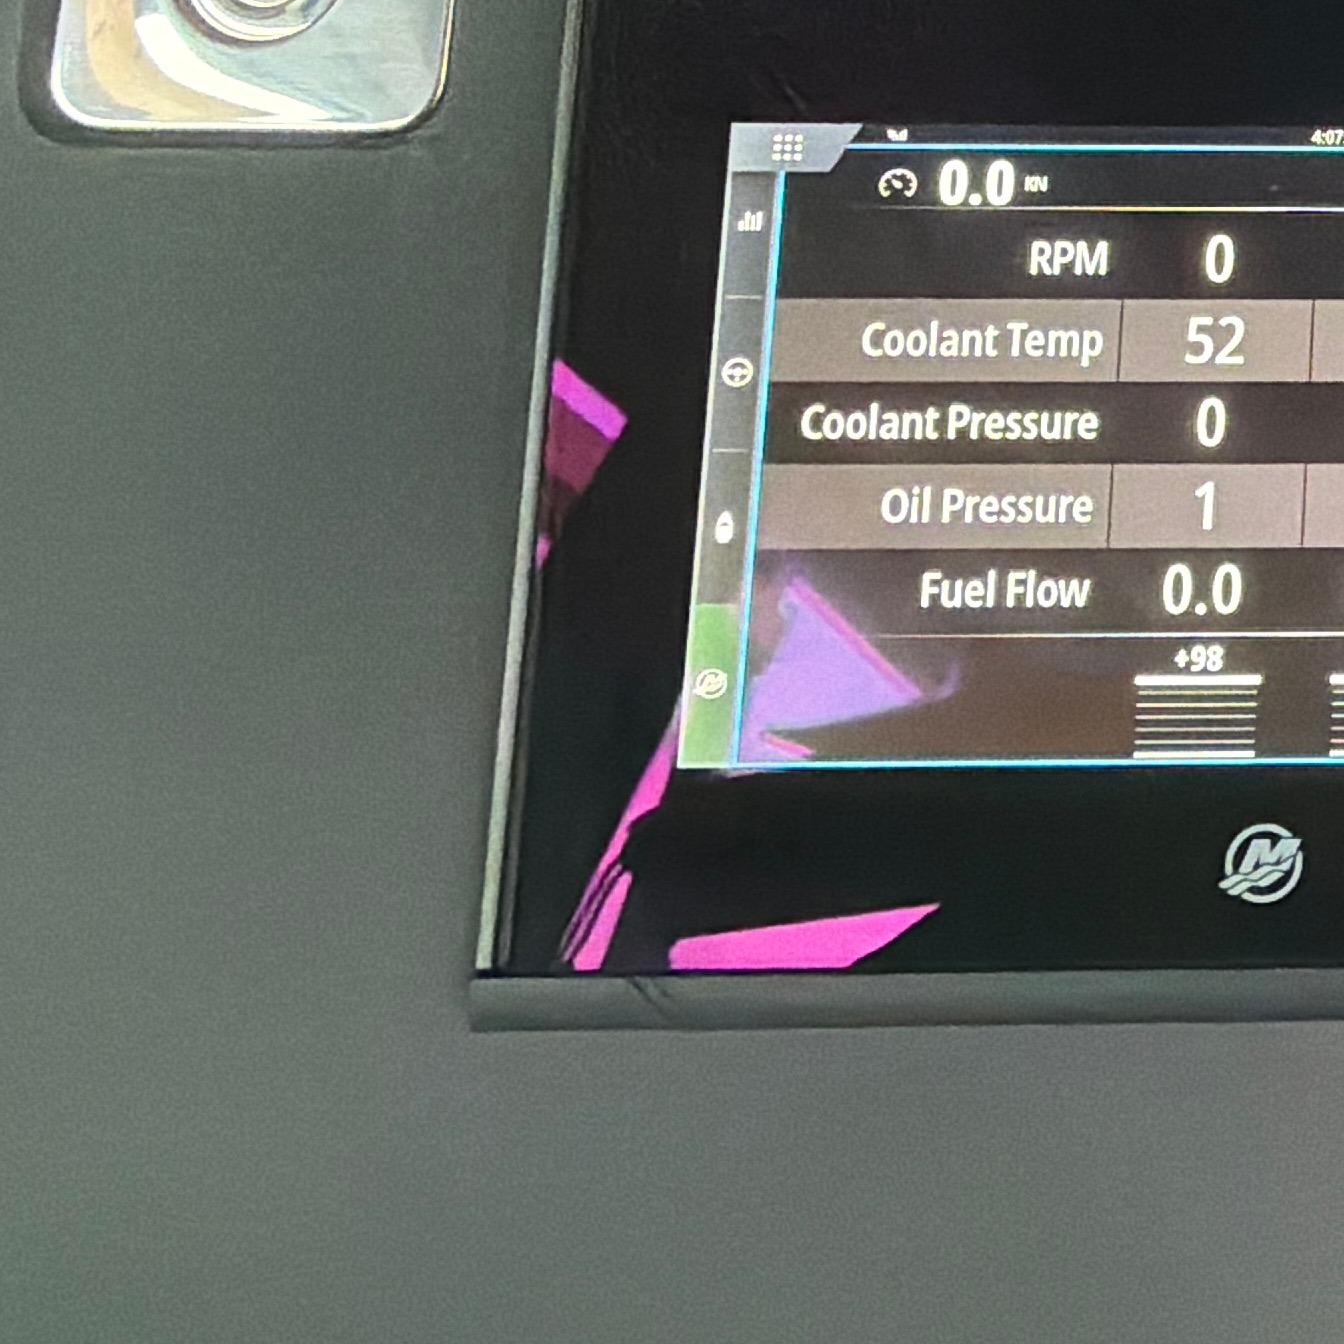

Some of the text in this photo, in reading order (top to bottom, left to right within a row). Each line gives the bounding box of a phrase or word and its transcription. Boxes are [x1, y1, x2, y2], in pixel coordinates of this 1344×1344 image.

[938, 159, 1048, 207] 0.0 KN
[1029, 239, 1108, 276] RPM
[1205, 233, 1236, 284] 0
[862, 319, 999, 359] Coolant
[1007, 321, 1103, 368] Temp
[1184, 315, 1246, 365] 52
[801, 402, 939, 442] Coolant
[947, 403, 1100, 442] Pressure
[1196, 395, 1227, 448] 0
[881, 485, 932, 524] Oil
[941, 487, 1094, 524] Pressure
[1194, 480, 1216, 531] 1
[919, 569, 999, 609] Fuel
[1005, 568, 1091, 609] Flow
[1161, 562, 1243, 616] 0.0
[1173, 644, 1224, 672] +98
